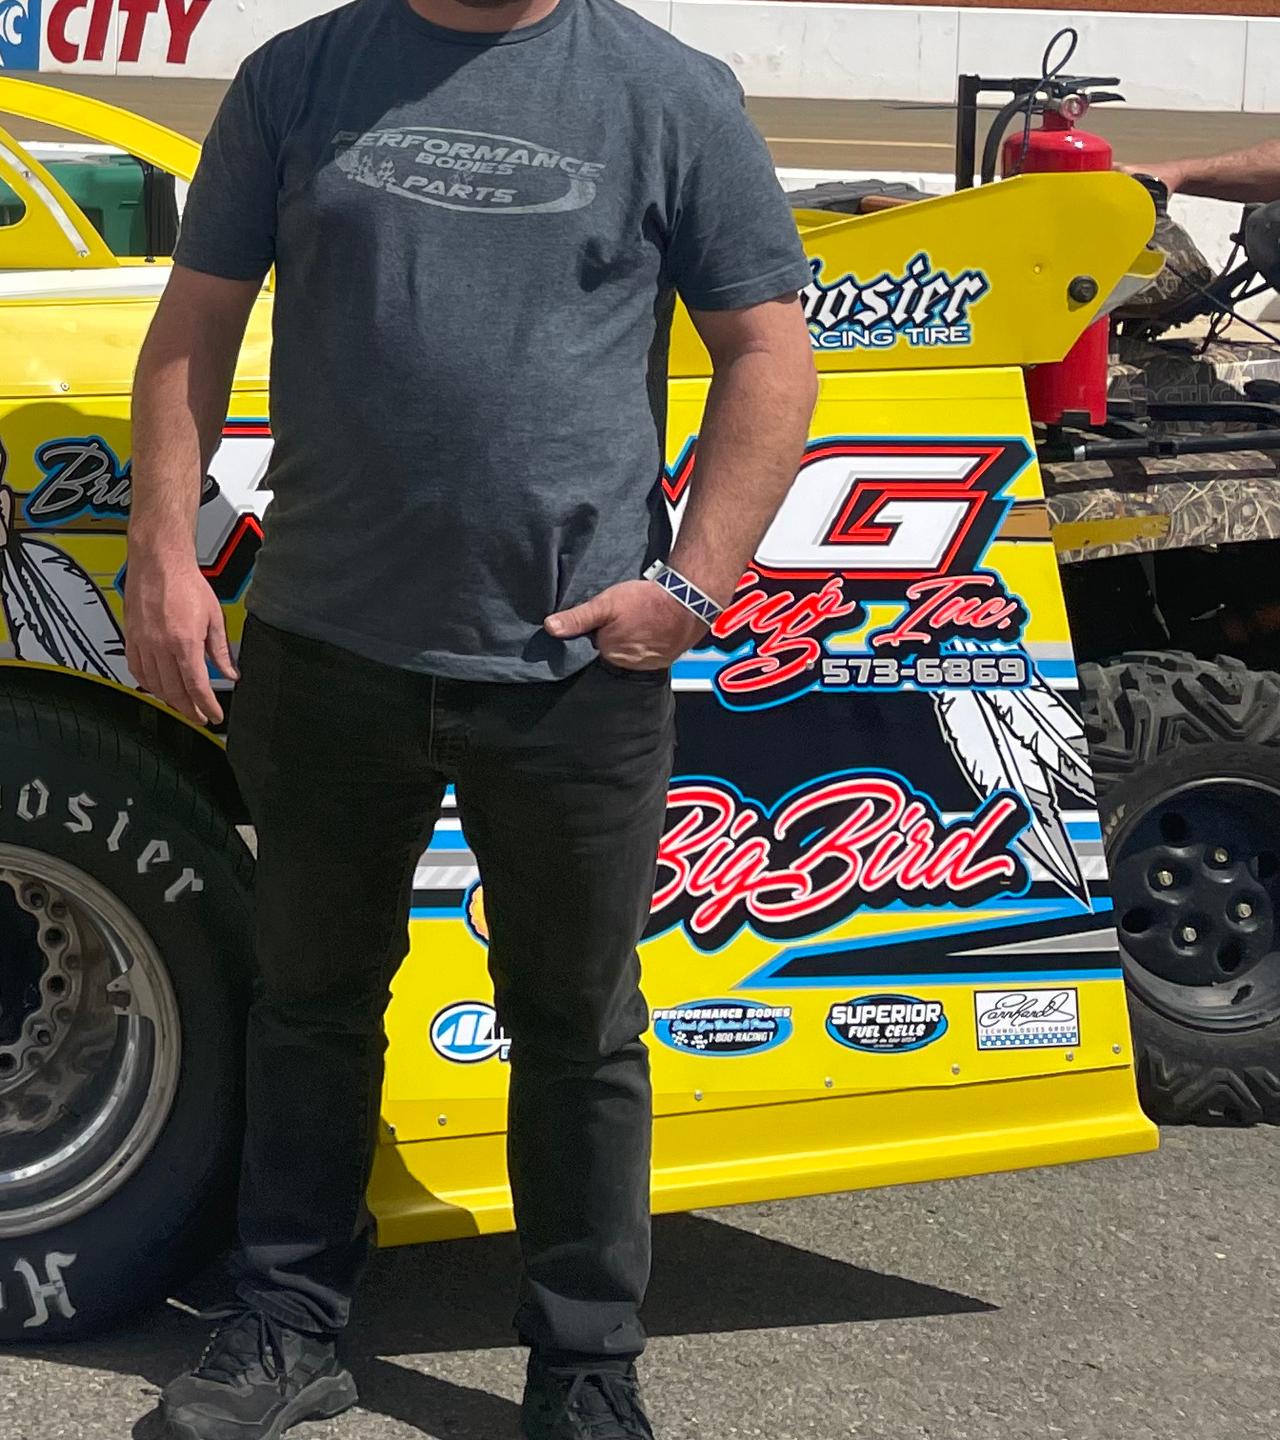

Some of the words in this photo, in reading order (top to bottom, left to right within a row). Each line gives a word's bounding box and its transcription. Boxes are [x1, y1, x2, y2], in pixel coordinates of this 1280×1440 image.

[332, 130, 606, 178] PERFORMANCE
[414, 152, 517, 176] BODIES
[402, 175, 519, 204] PARTS
[906, 326, 969, 344] TIRE
[821, 658, 1026, 685] 573-6869
[652, 1008, 744, 1020] PERFORMANCE
[746, 1007, 791, 1019] BODIES
[831, 1002, 942, 1025] SUPERIOR
[847, 1025, 881, 1038] FUEL
[884, 1023, 927, 1038] CELLS
